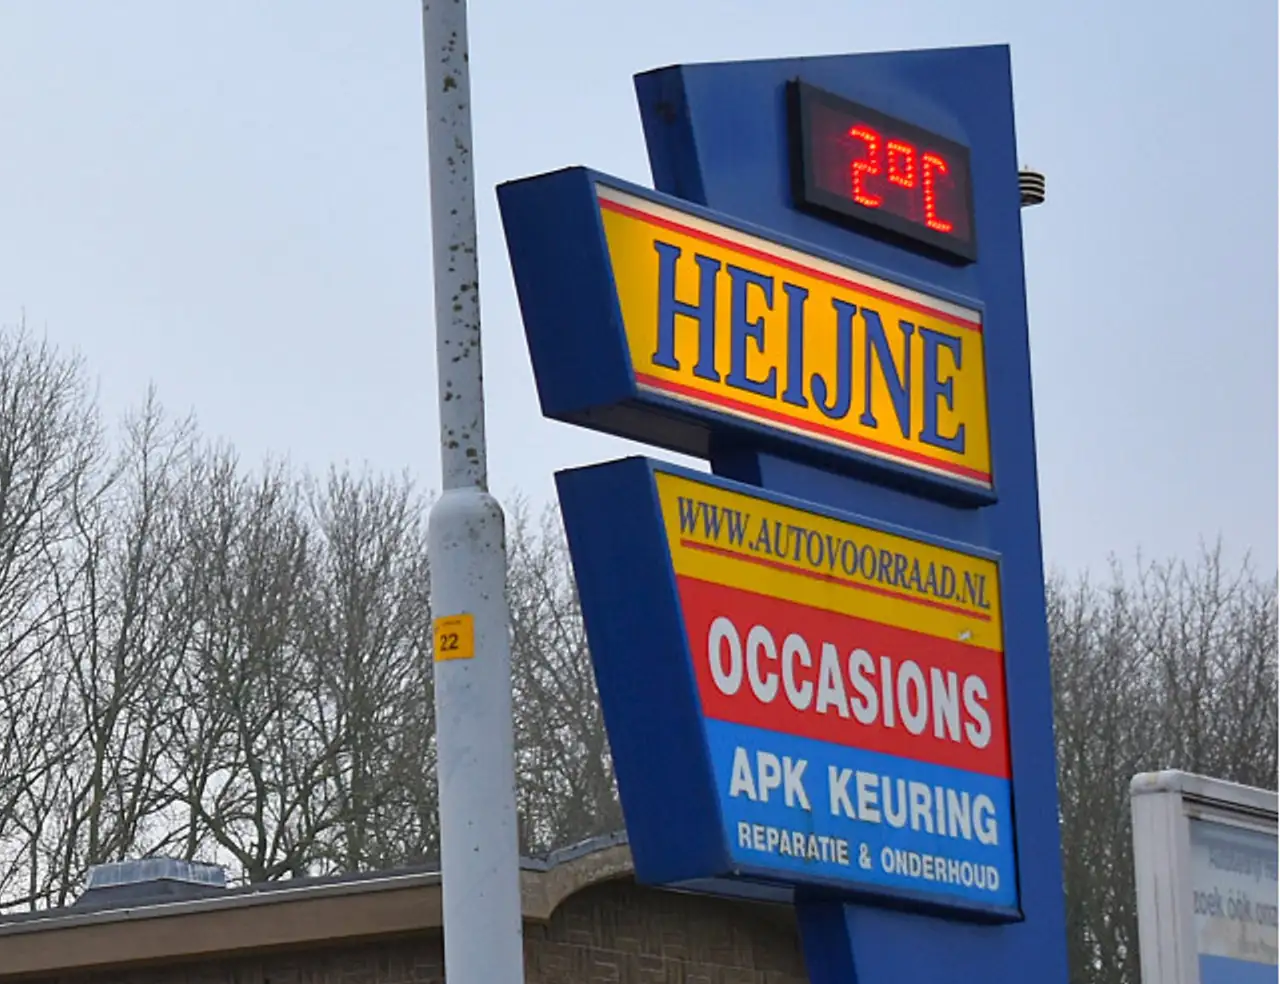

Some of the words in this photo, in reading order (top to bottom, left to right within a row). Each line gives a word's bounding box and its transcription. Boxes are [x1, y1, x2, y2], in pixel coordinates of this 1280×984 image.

[651, 239, 966, 455] HEIJNE
[676, 495, 992, 610] WWW.AUTOVOORRAAD.NL
[439, 632, 459, 652] 22
[707, 615, 992, 750] OCCASIONS
[729, 745, 811, 813] APK
[827, 765, 999, 846] KEURING
[737, 821, 850, 866] REPARATIE
[858, 842, 873, 870] &
[880, 846, 1000, 892] ONDERHOUD
